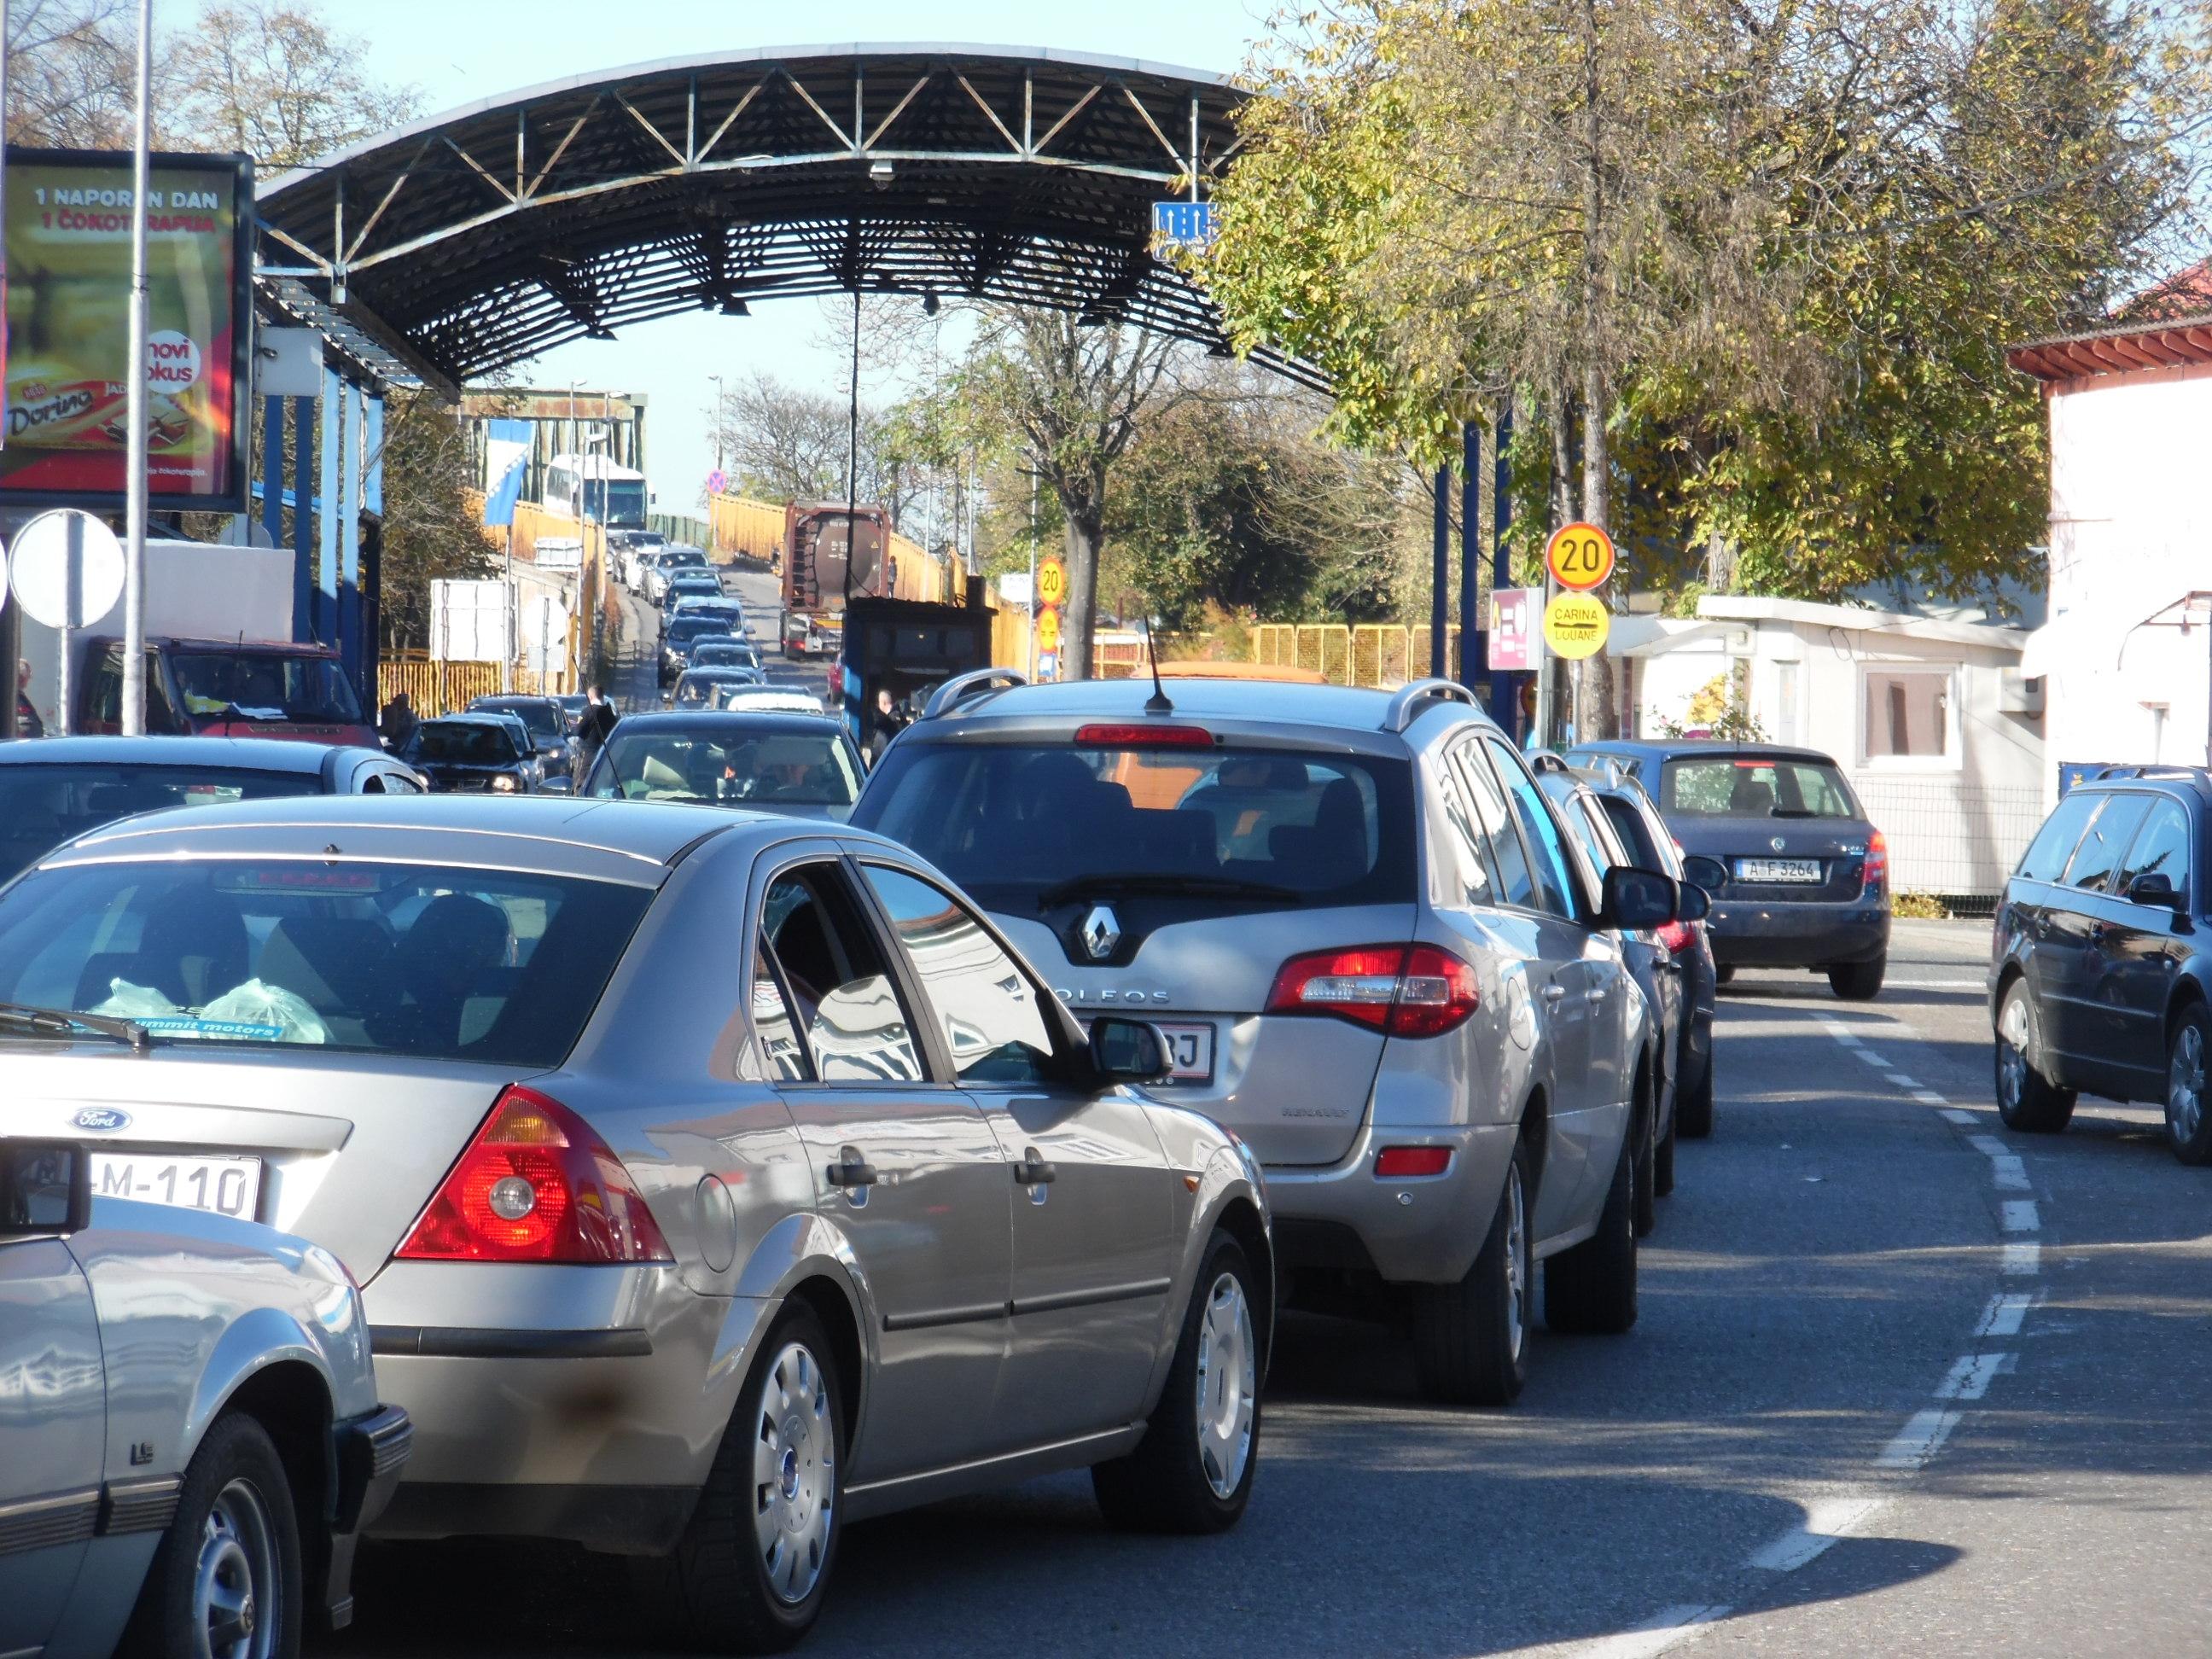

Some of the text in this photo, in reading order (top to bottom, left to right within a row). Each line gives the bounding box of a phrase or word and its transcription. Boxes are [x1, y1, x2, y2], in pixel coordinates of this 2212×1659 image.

[35, 188, 218, 210] 1 NAPORN DAN
[43, 208, 216, 233] 1 ČOKOTRAPIJA
[8, 389, 93, 436] Dorina
[1561, 538, 1600, 573] 20
[1043, 570, 1059, 592] 20
[1554, 608, 1598, 621] CARINA
[1750, 861, 1814, 876] A F 3264
[1055, 988, 1171, 1004] OLEOS
[135, 1020, 276, 1037] ummit motors
